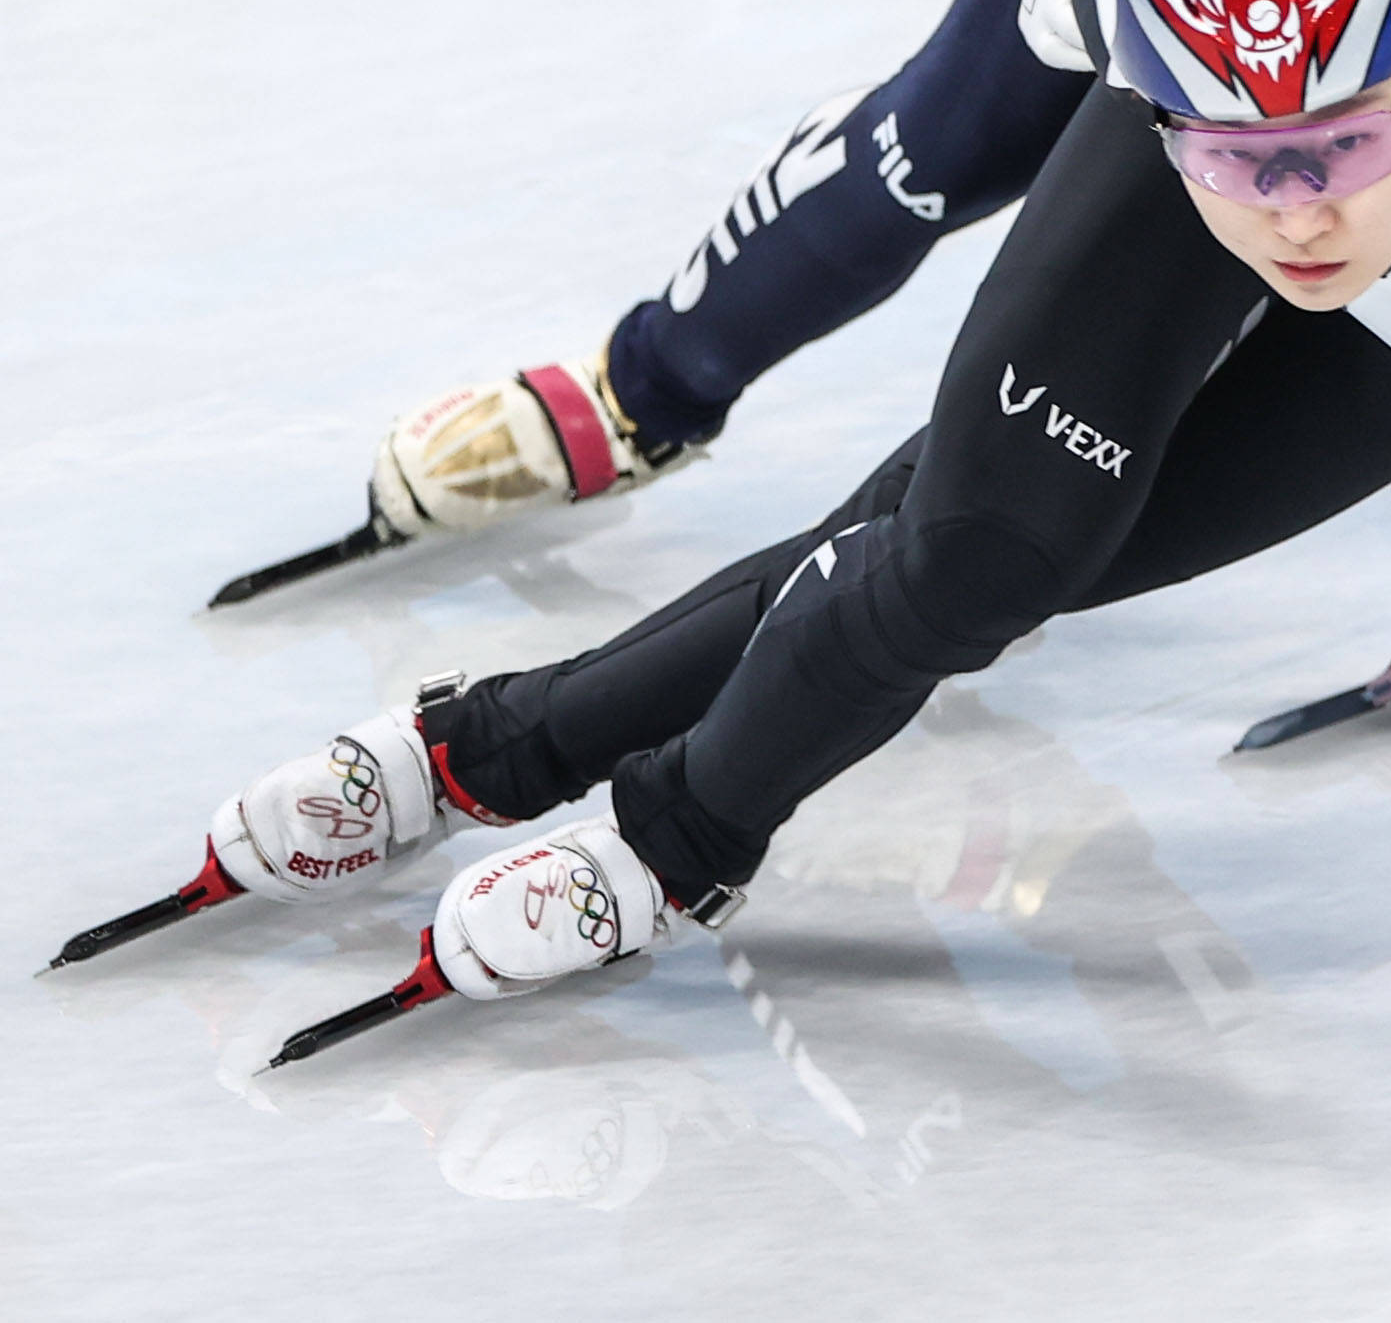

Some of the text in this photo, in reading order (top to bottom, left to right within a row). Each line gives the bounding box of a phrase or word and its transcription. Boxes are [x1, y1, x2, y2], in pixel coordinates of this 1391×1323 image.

[871, 110, 946, 221] FILA
[1044, 403, 1133, 480] V-EXX
[287, 846, 381, 881] BEST FEEL
